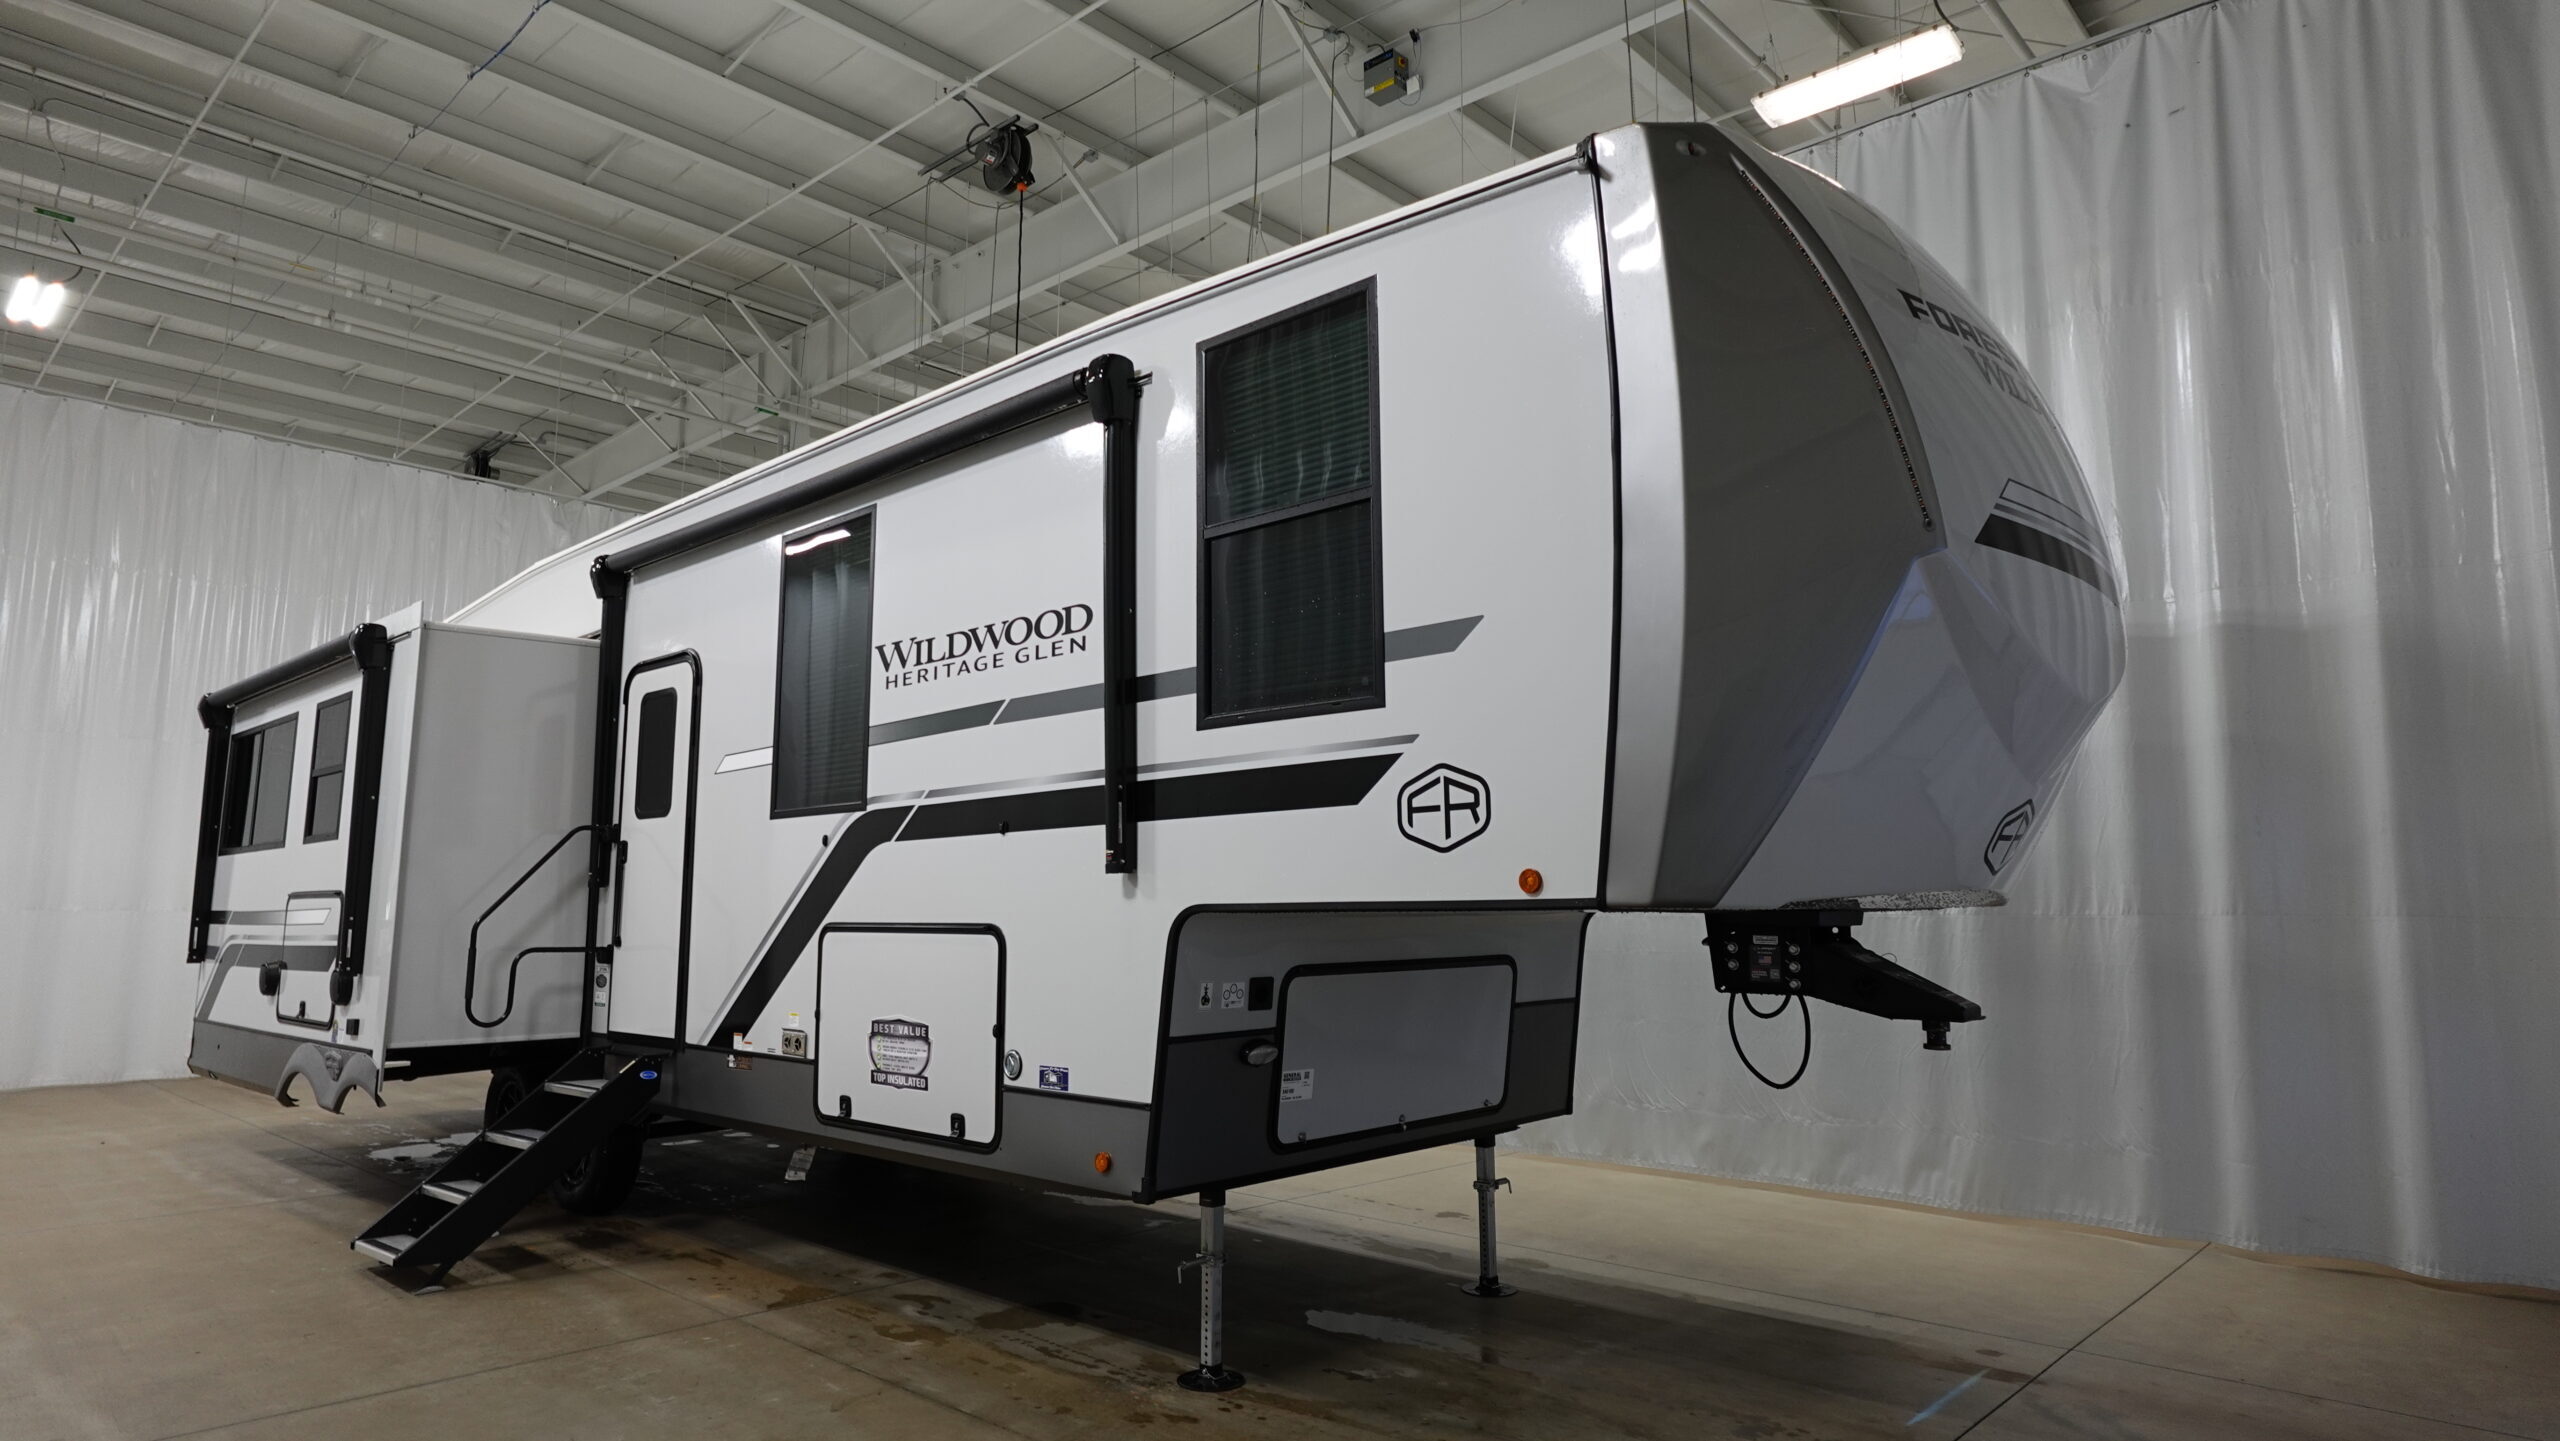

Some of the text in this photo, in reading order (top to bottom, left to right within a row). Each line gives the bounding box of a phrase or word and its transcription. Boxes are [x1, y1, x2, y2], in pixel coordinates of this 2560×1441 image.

[1898, 288, 2019, 373] FORES
[1963, 344, 2042, 415] WILD
[875, 603, 1094, 673] WILDWOOD
[885, 635, 1087, 690] HERITAGE GLEN
[1407, 775, 1481, 840] FR
[873, 1023, 927, 1037] BEST VALUE
[873, 1072, 926, 1089] TOP INSULATED
